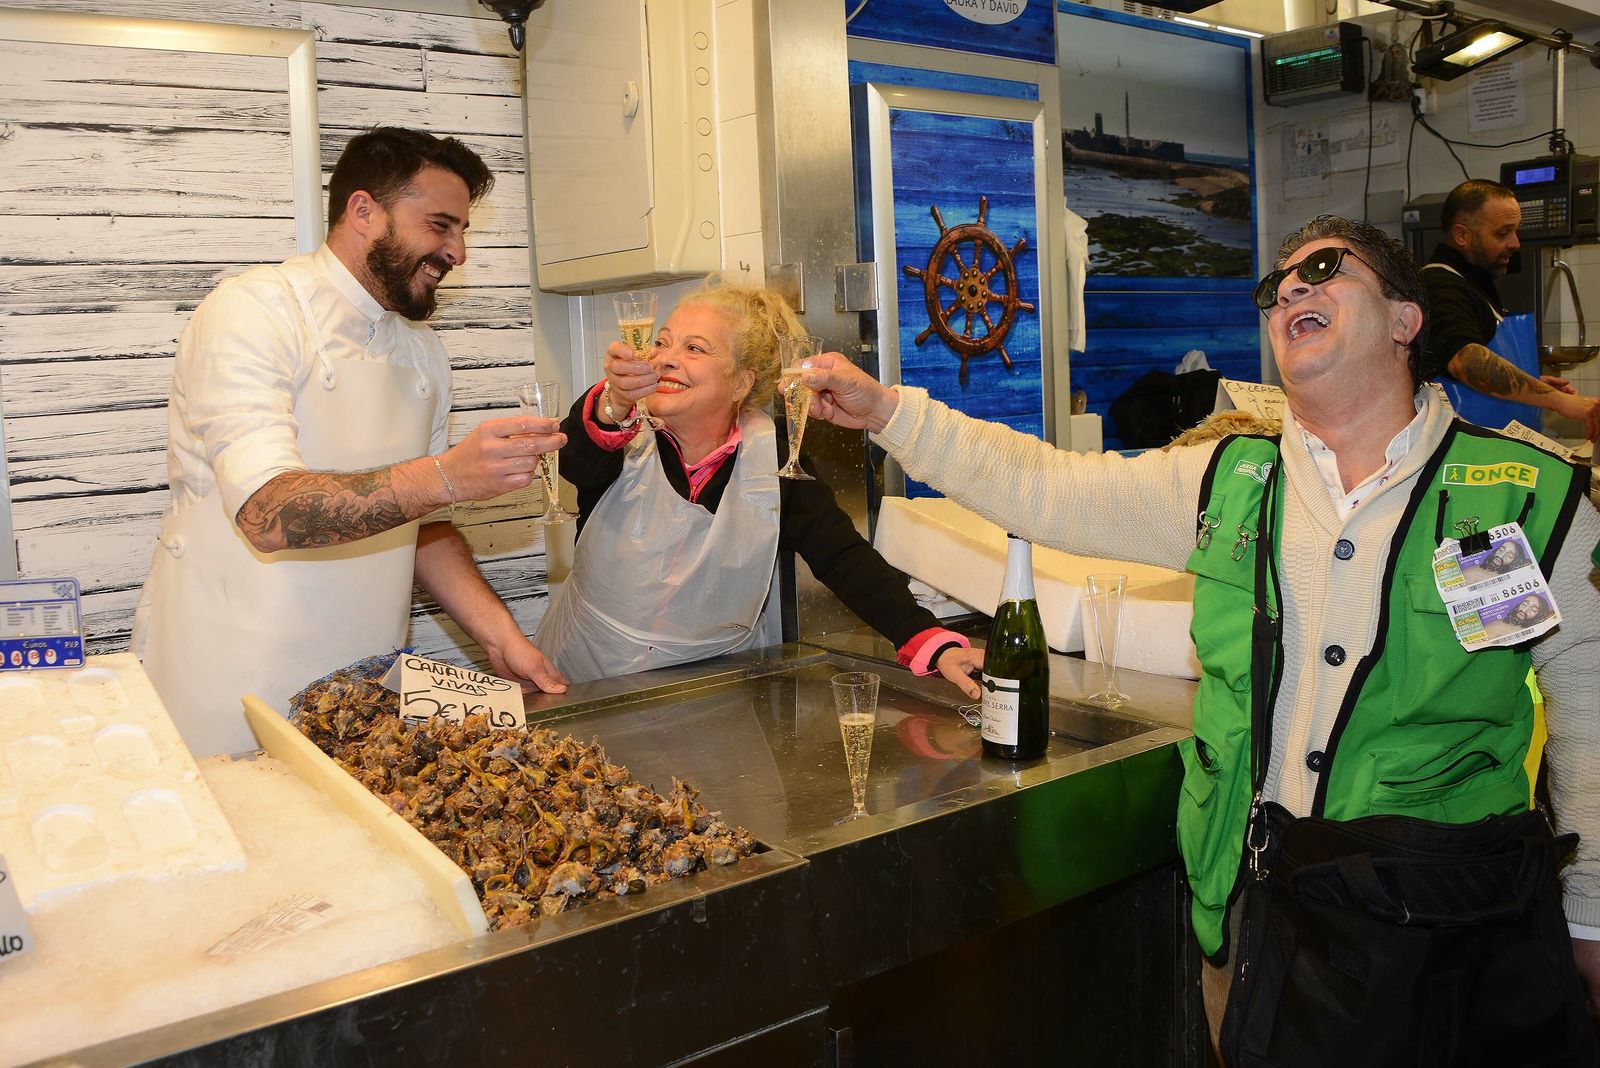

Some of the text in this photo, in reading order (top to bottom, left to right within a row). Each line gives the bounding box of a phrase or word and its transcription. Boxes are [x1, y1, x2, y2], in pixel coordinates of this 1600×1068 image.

[981, 0, 987, 9] Y
[989, 0, 1019, 15] DAVID
[1471, 465, 1531, 482] ONCE
[1489, 526, 1517, 541] 6506
[1502, 579, 1540, 598] 86506
[991, 702, 1014, 711] SERRA
